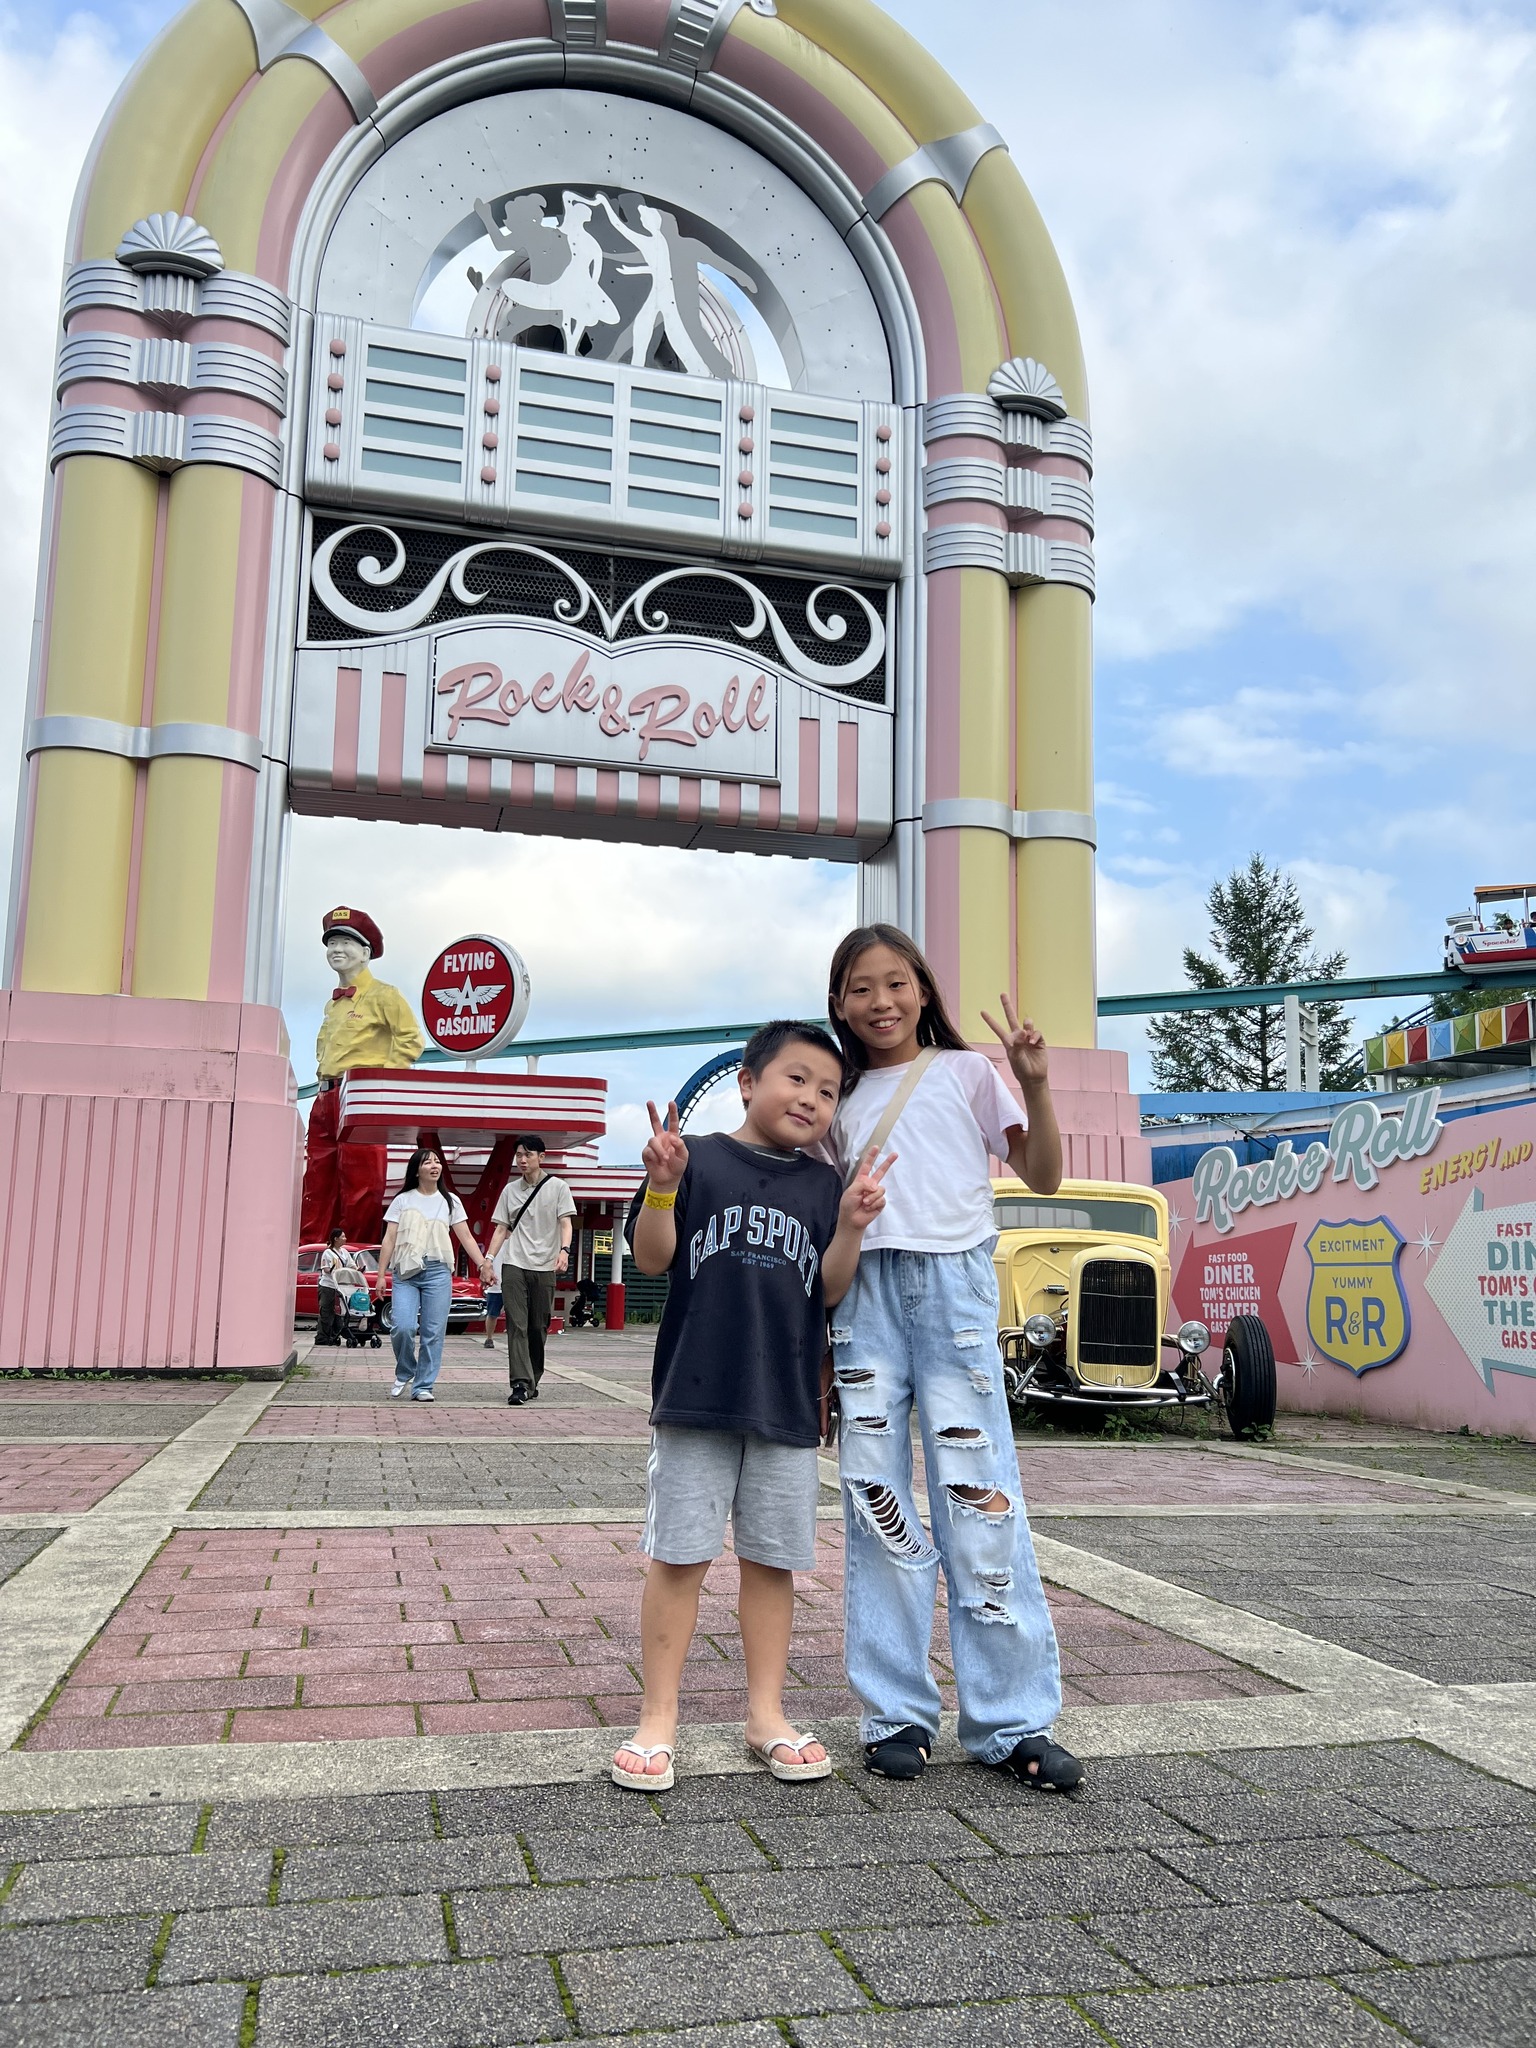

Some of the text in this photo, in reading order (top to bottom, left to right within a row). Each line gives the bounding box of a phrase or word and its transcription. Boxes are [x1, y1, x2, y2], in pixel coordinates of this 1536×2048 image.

[443, 951, 495, 973] FLYING
[436, 1015, 496, 1036] GASOLINE
[1420, 1136, 1534, 1195] ENERGY AND
[1497, 1222, 1532, 1237] FAST
[690, 1205, 742, 1280] GAP
[747, 1205, 819, 1298] SPORT
[1320, 1239, 1385, 1252] EXCITMENT
[747, 1252, 787, 1266] FRANCISCO
[759, 1260, 775, 1269] 1969
[1208, 1253, 1248, 1263] FAST FOOD
[1204, 1264, 1255, 1285] DINER
[1332, 1277, 1373, 1289] YUMMY
[1478, 1275, 1528, 1296] TOM'S
[1200, 1286, 1261, 1300] TOM'S CHICKEN
[1202, 1302, 1260, 1319] THEATER
[1210, 1321, 1223, 1333] GAS
[1502, 1330, 1528, 1350] GAS
